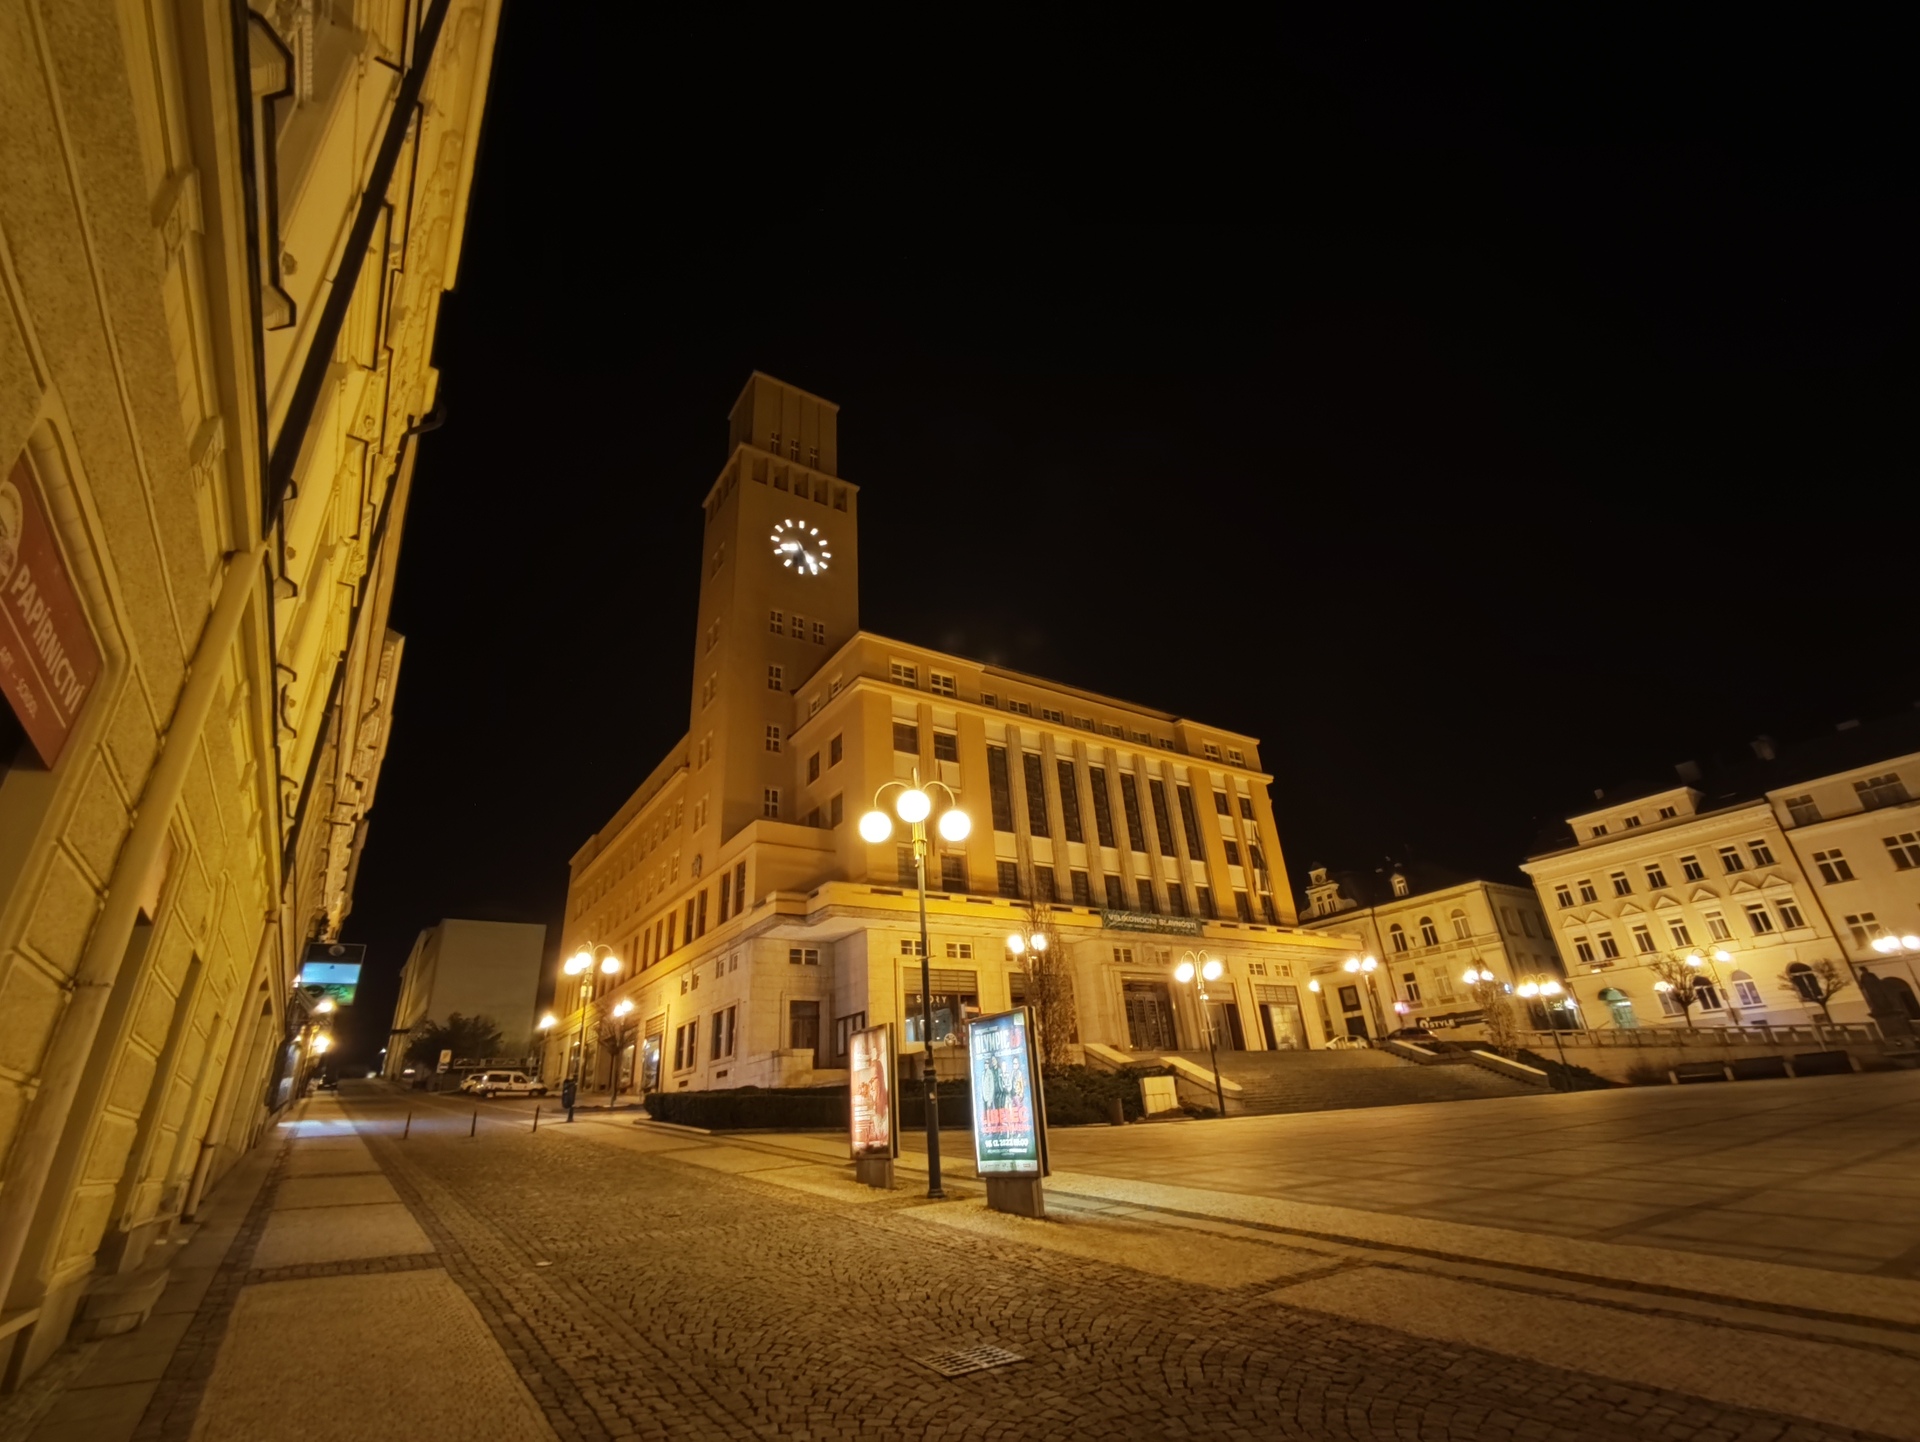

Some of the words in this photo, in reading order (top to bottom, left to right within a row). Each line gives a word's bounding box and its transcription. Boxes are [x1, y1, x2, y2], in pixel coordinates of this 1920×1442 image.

[10, 564, 86, 715] PAPÍRNICTVÍ
[916, 994, 947, 1004] SORY
[975, 1030, 1010, 1053] OLYMPIC
[981, 1106, 1029, 1126] LIBEREC
